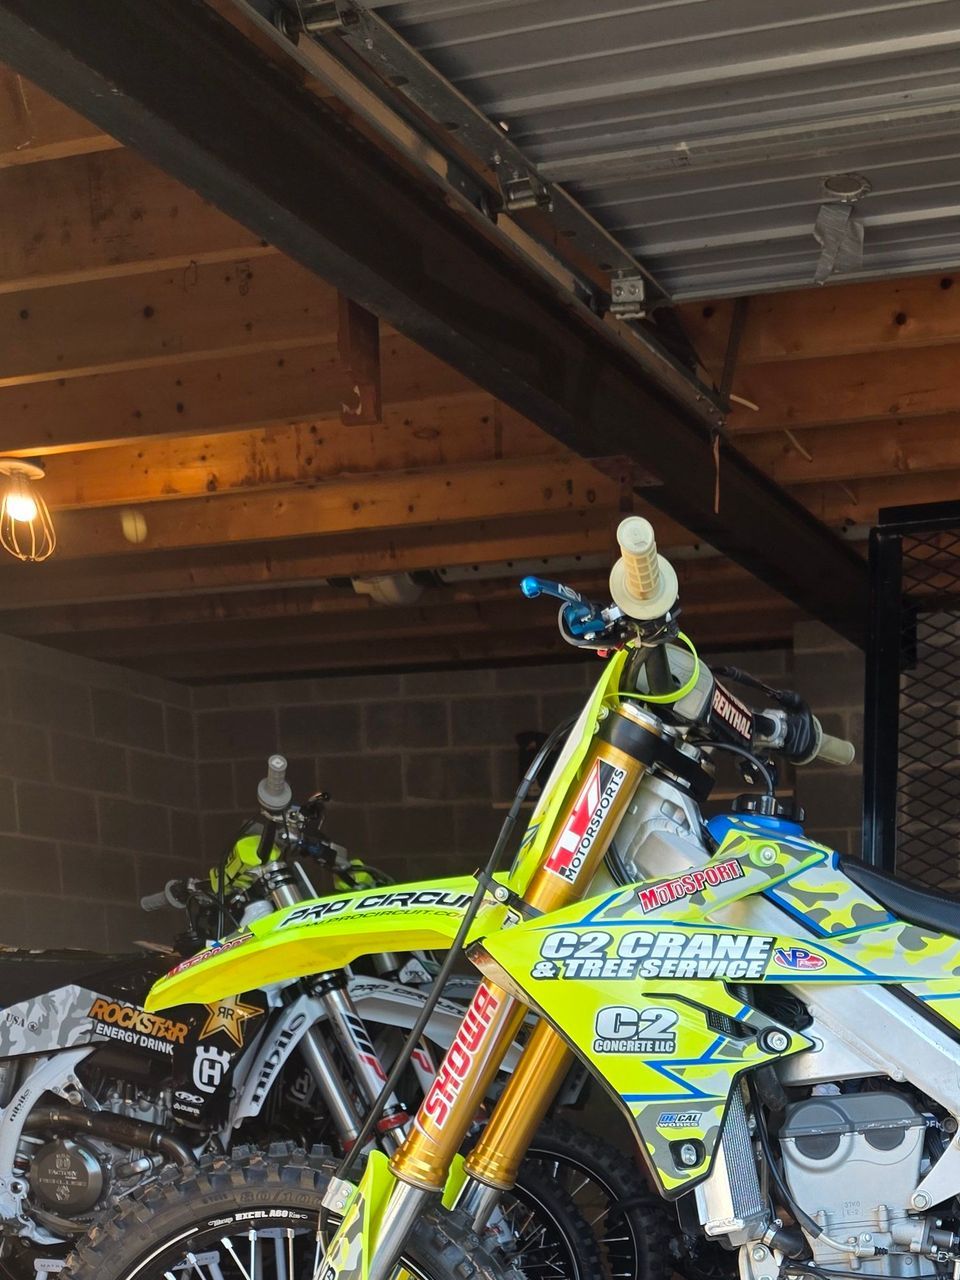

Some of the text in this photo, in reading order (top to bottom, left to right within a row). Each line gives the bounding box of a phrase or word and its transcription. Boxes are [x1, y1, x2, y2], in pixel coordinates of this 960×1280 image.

[713, 688, 751, 740] RENTHAL
[565, 768, 625, 881] MOTORSPORTS
[279, 891, 477, 928] PRO CIRCUI
[541, 931, 774, 960] C2 CRANE
[775, 948, 812, 969] VP
[532, 958, 766, 980] & TREE SERVICE
[4, 1012, 26, 1028] USA
[87, 998, 190, 1045] ROCKSTAR
[596, 1007, 679, 1041] C2
[95, 1023, 175, 1056] ENERGY DRINK
[594, 1039, 675, 1053] CONCRETE LLC
[421, 983, 500, 1131] SHOWA
[235, 1210, 269, 1221] EXCEL
